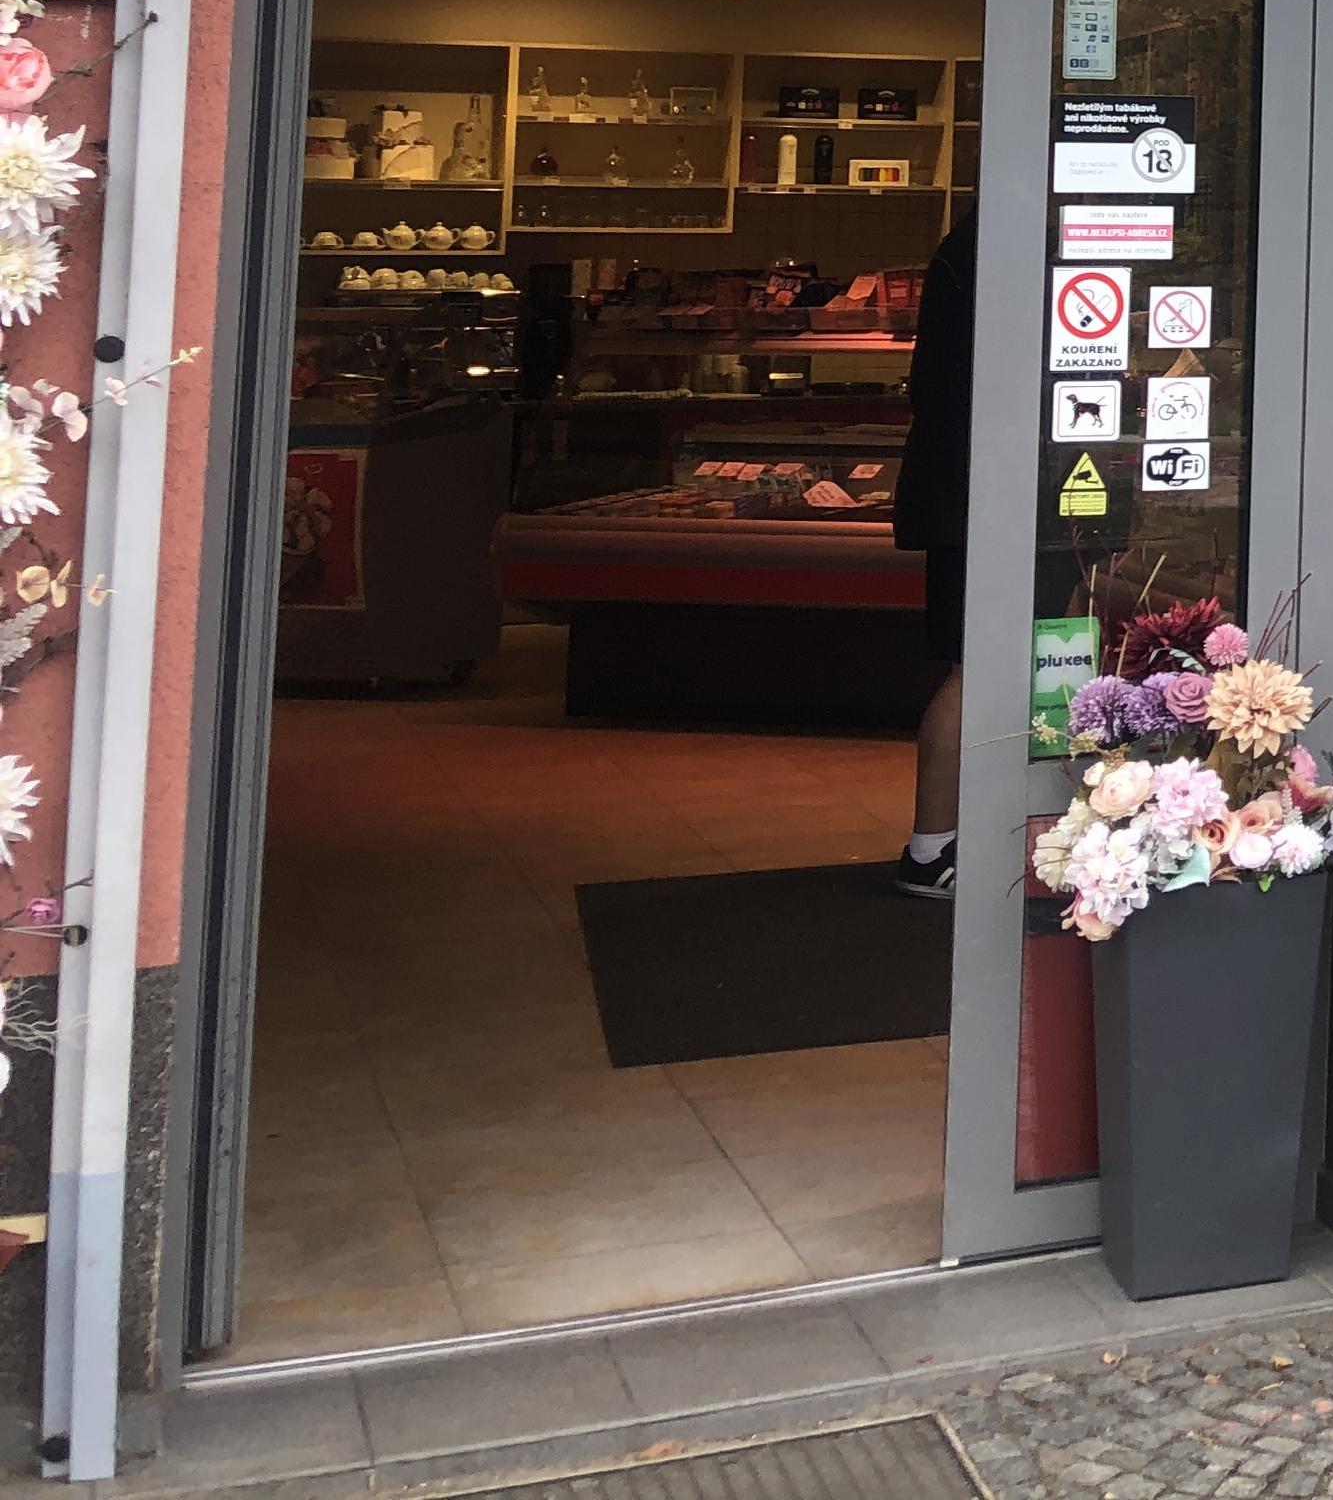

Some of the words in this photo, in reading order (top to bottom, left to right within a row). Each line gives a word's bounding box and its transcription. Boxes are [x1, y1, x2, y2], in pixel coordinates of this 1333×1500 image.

[1064, 102, 1114, 113] Nezletilým
[1114, 102, 1157, 112] tabákové
[1064, 114, 1079, 122] ani
[1080, 113, 1128, 123] nikotinové
[1129, 114, 1167, 124] výrobky
[1063, 124, 1129, 134] neprodáváme.
[1142, 149, 1173, 173] 18
[1061, 343, 1118, 355] KOUŘENÍ
[1055, 356, 1123, 368] ZAKÁZÁNO
[1037, 653, 1093, 672] pluxee
